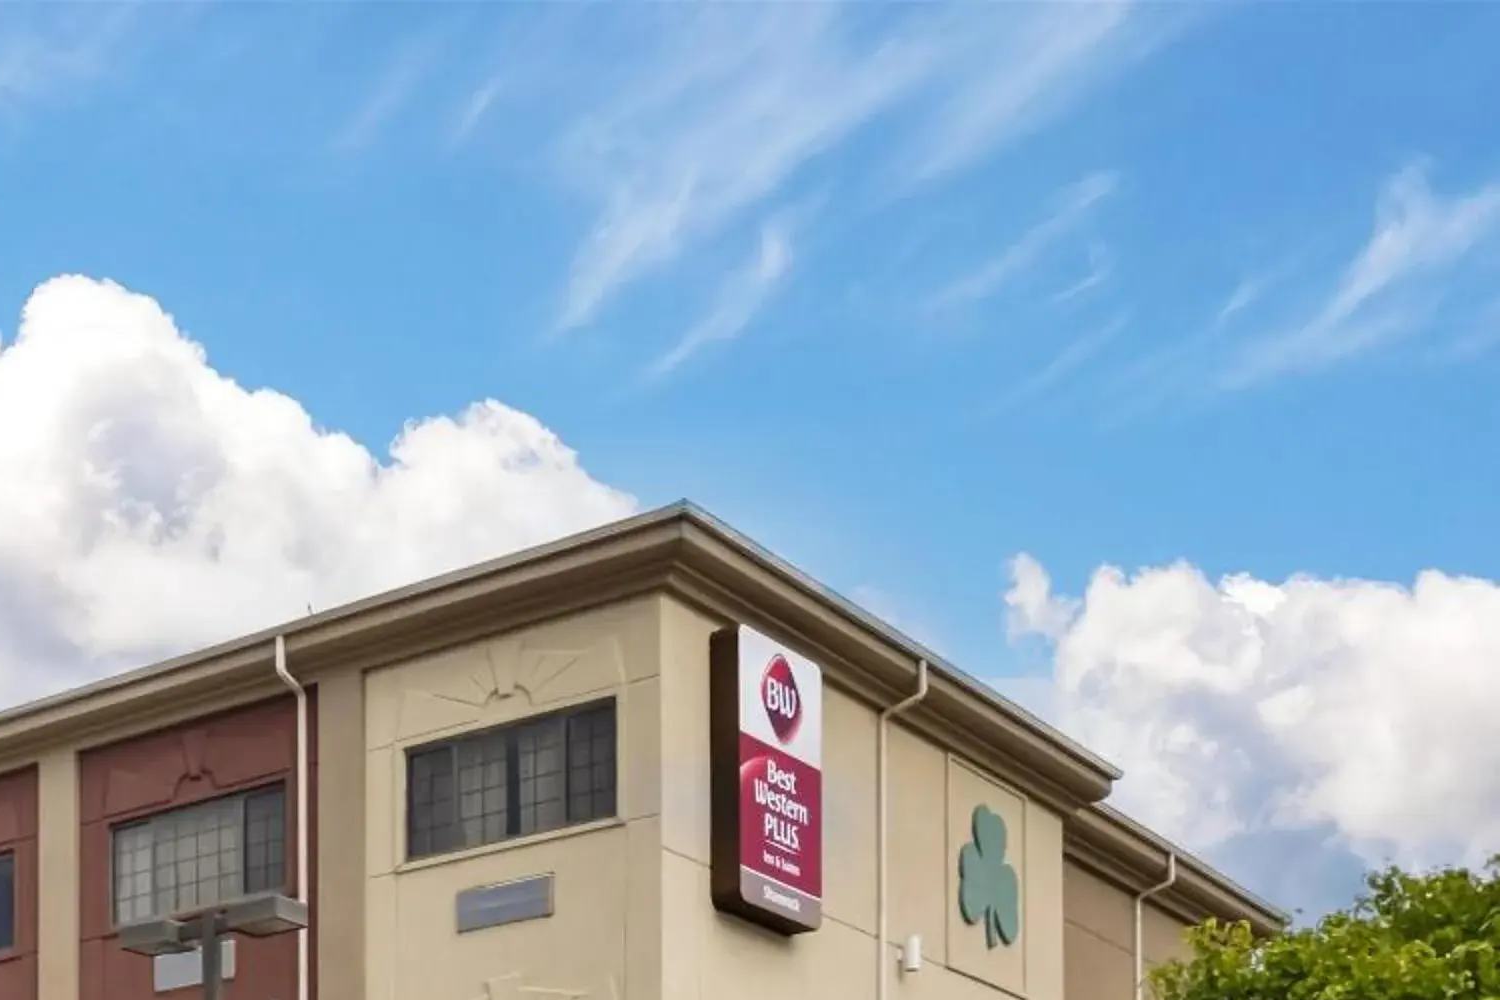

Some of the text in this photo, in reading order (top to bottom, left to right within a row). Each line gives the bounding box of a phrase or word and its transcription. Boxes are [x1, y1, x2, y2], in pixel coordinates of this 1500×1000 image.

[766, 677, 797, 719] BW
[767, 759, 796, 794] Best
[754, 778, 808, 826] Western
[764, 813, 799, 849] PLUS
